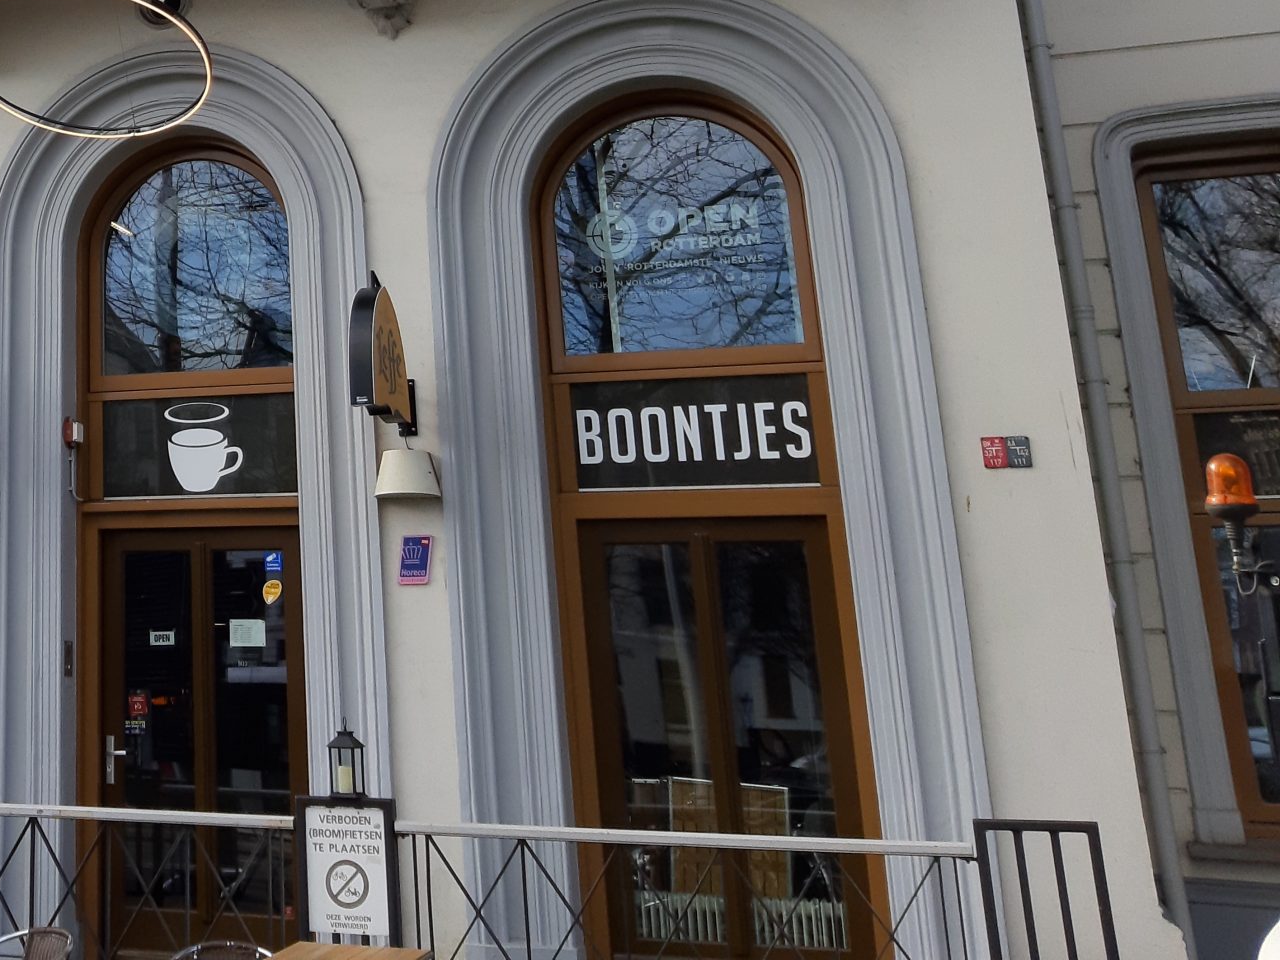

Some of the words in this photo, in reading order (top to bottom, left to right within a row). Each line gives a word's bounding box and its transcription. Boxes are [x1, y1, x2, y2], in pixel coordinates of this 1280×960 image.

[647, 198, 759, 235] OPEN
[650, 232, 761, 253] ROTTERDAM
[720, 254, 765, 265] NIEUWS
[576, 401, 812, 465] BOONTJES
[401, 569, 426, 577] Horeca
[154, 634, 170, 643] OPEN
[318, 814, 372, 826] VERBODEN
[308, 827, 382, 841] (BROM)FIETSEN
[312, 842, 325, 853] TE
[328, 843, 380, 855] PLAATSEN
[326, 913, 341, 921] DEZE
[344, 915, 372, 923] WORDEN
